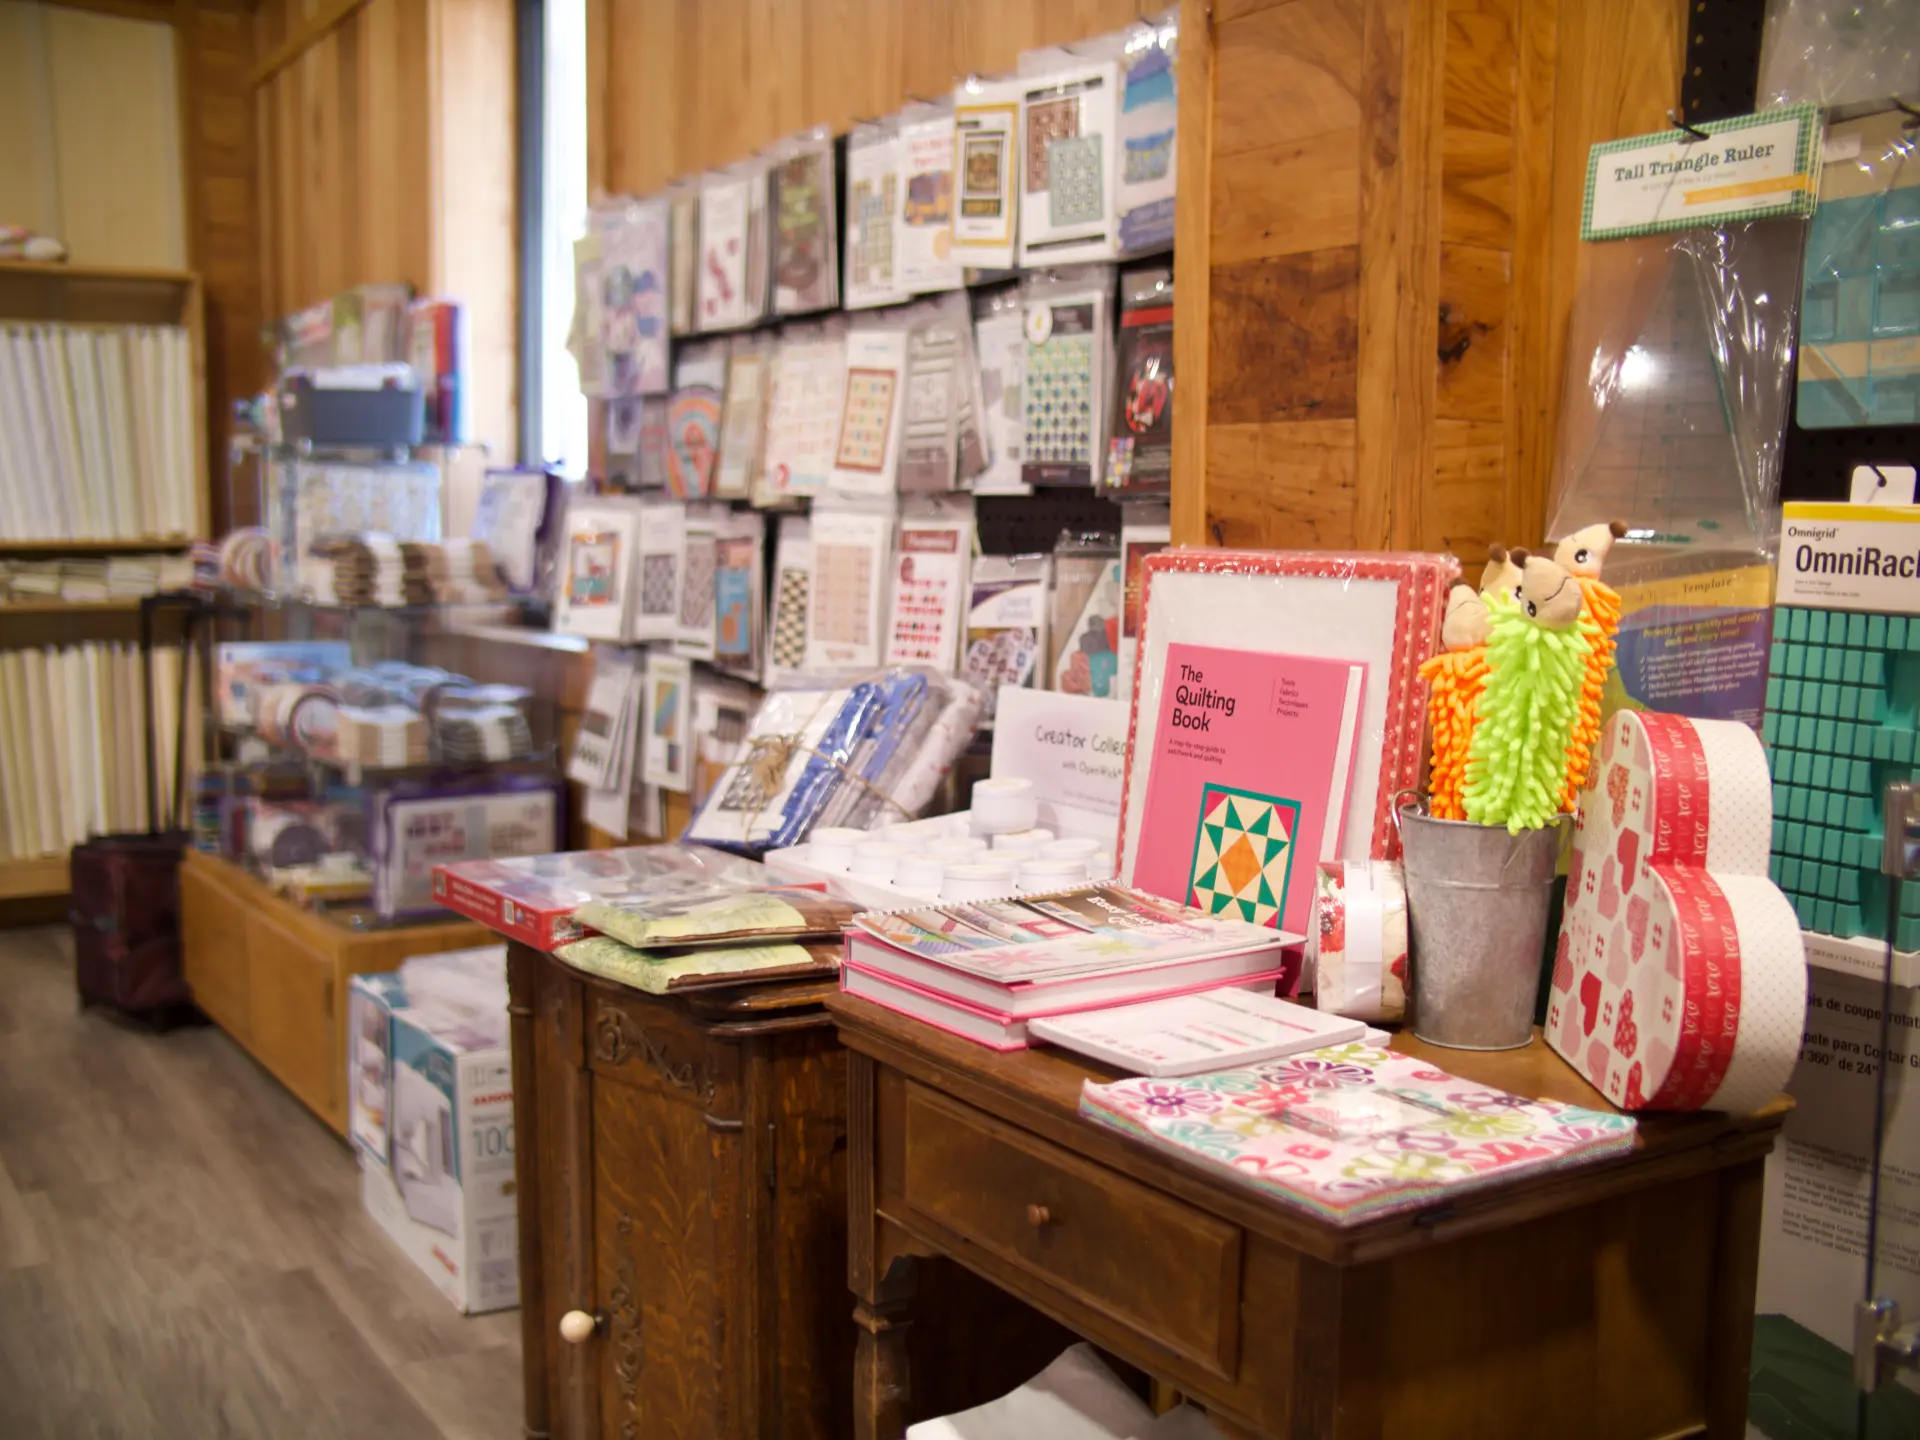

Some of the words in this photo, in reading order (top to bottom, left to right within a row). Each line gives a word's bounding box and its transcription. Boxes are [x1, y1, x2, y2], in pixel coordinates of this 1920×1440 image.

[1614, 164, 1645, 182] Tall
[1650, 153, 1719, 177] Triangle
[1724, 144, 1775, 164] Ruler
[1788, 526, 1836, 541] Omnigrid
[1181, 664, 1203, 683] The
[1175, 684, 1236, 717] Quilting
[1172, 707, 1211, 732] Book
[1035, 725, 1087, 749] Creator
[1826, 997, 1841, 1012] de
[1844, 1002, 1882, 1020] coupe
[1832, 1039, 1860, 1055] para
[1838, 1058, 1853, 1071] de
